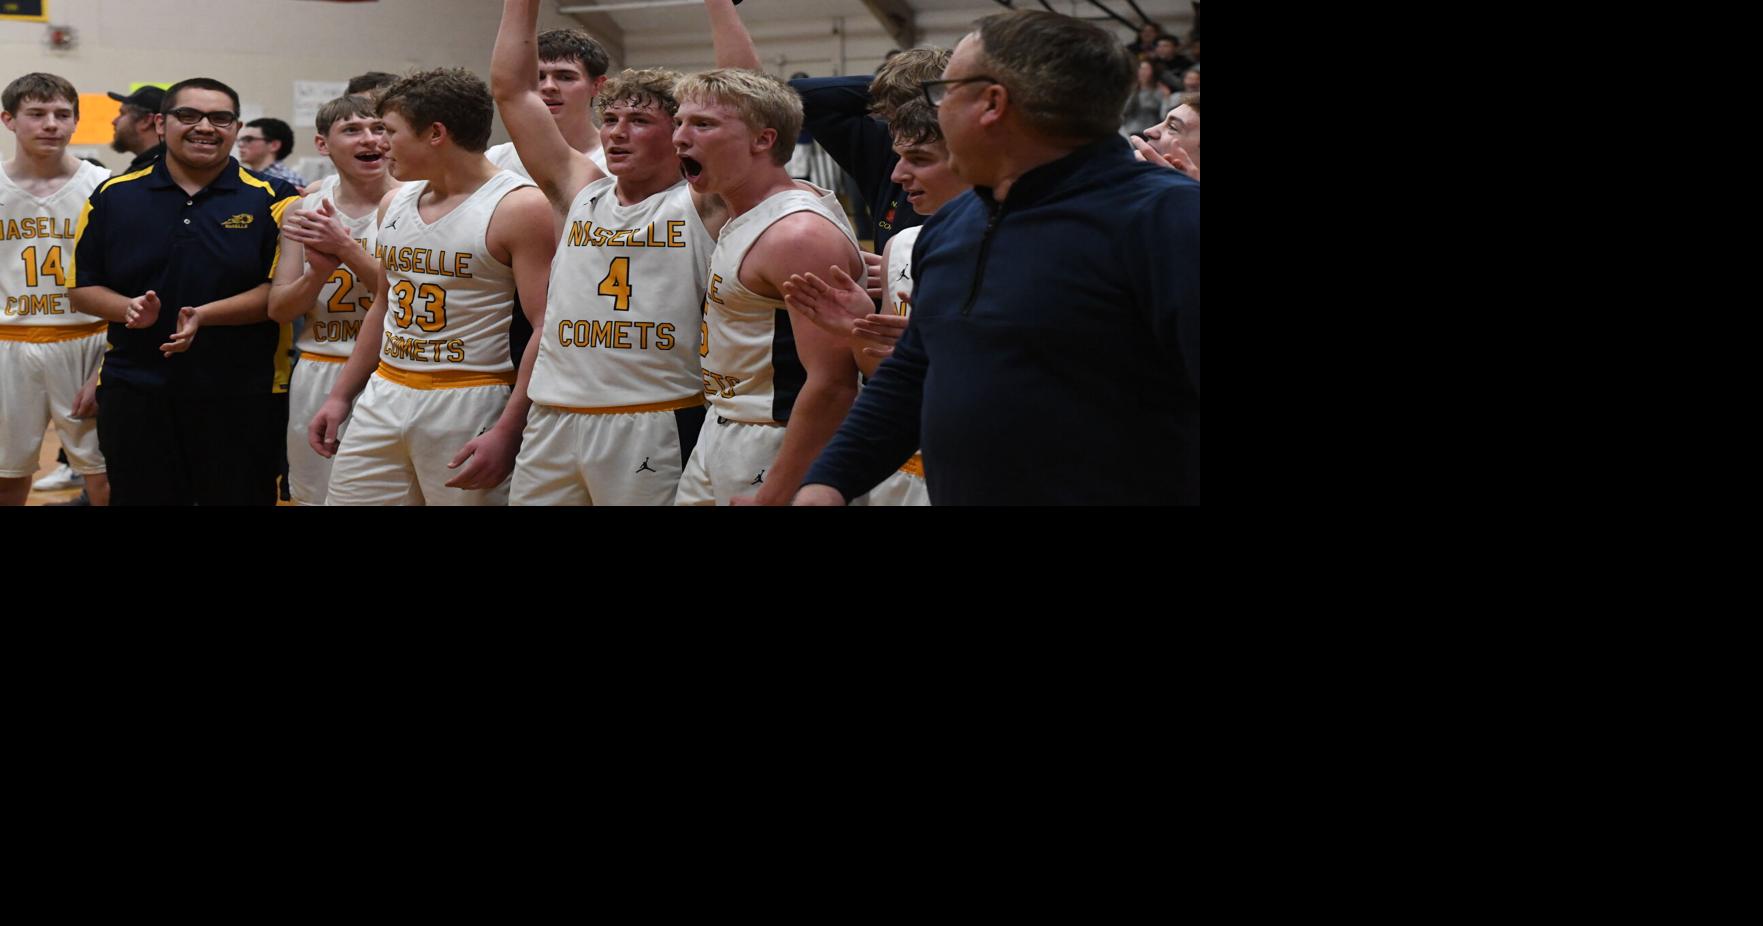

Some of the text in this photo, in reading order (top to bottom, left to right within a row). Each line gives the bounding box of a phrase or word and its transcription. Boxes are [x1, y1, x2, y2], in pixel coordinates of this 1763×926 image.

[0, 216, 75, 240] ASELL
[568, 220, 686, 248] NASELLE
[21, 245, 65, 288] 14
[598, 256, 632, 312] 4
[4, 293, 78, 316] COME
[393, 280, 447, 332] 33
[313, 320, 362, 342] COM
[558, 319, 676, 351] COMETS
[384, 331, 465, 363] COMETS
[701, 368, 740, 399] ETS
